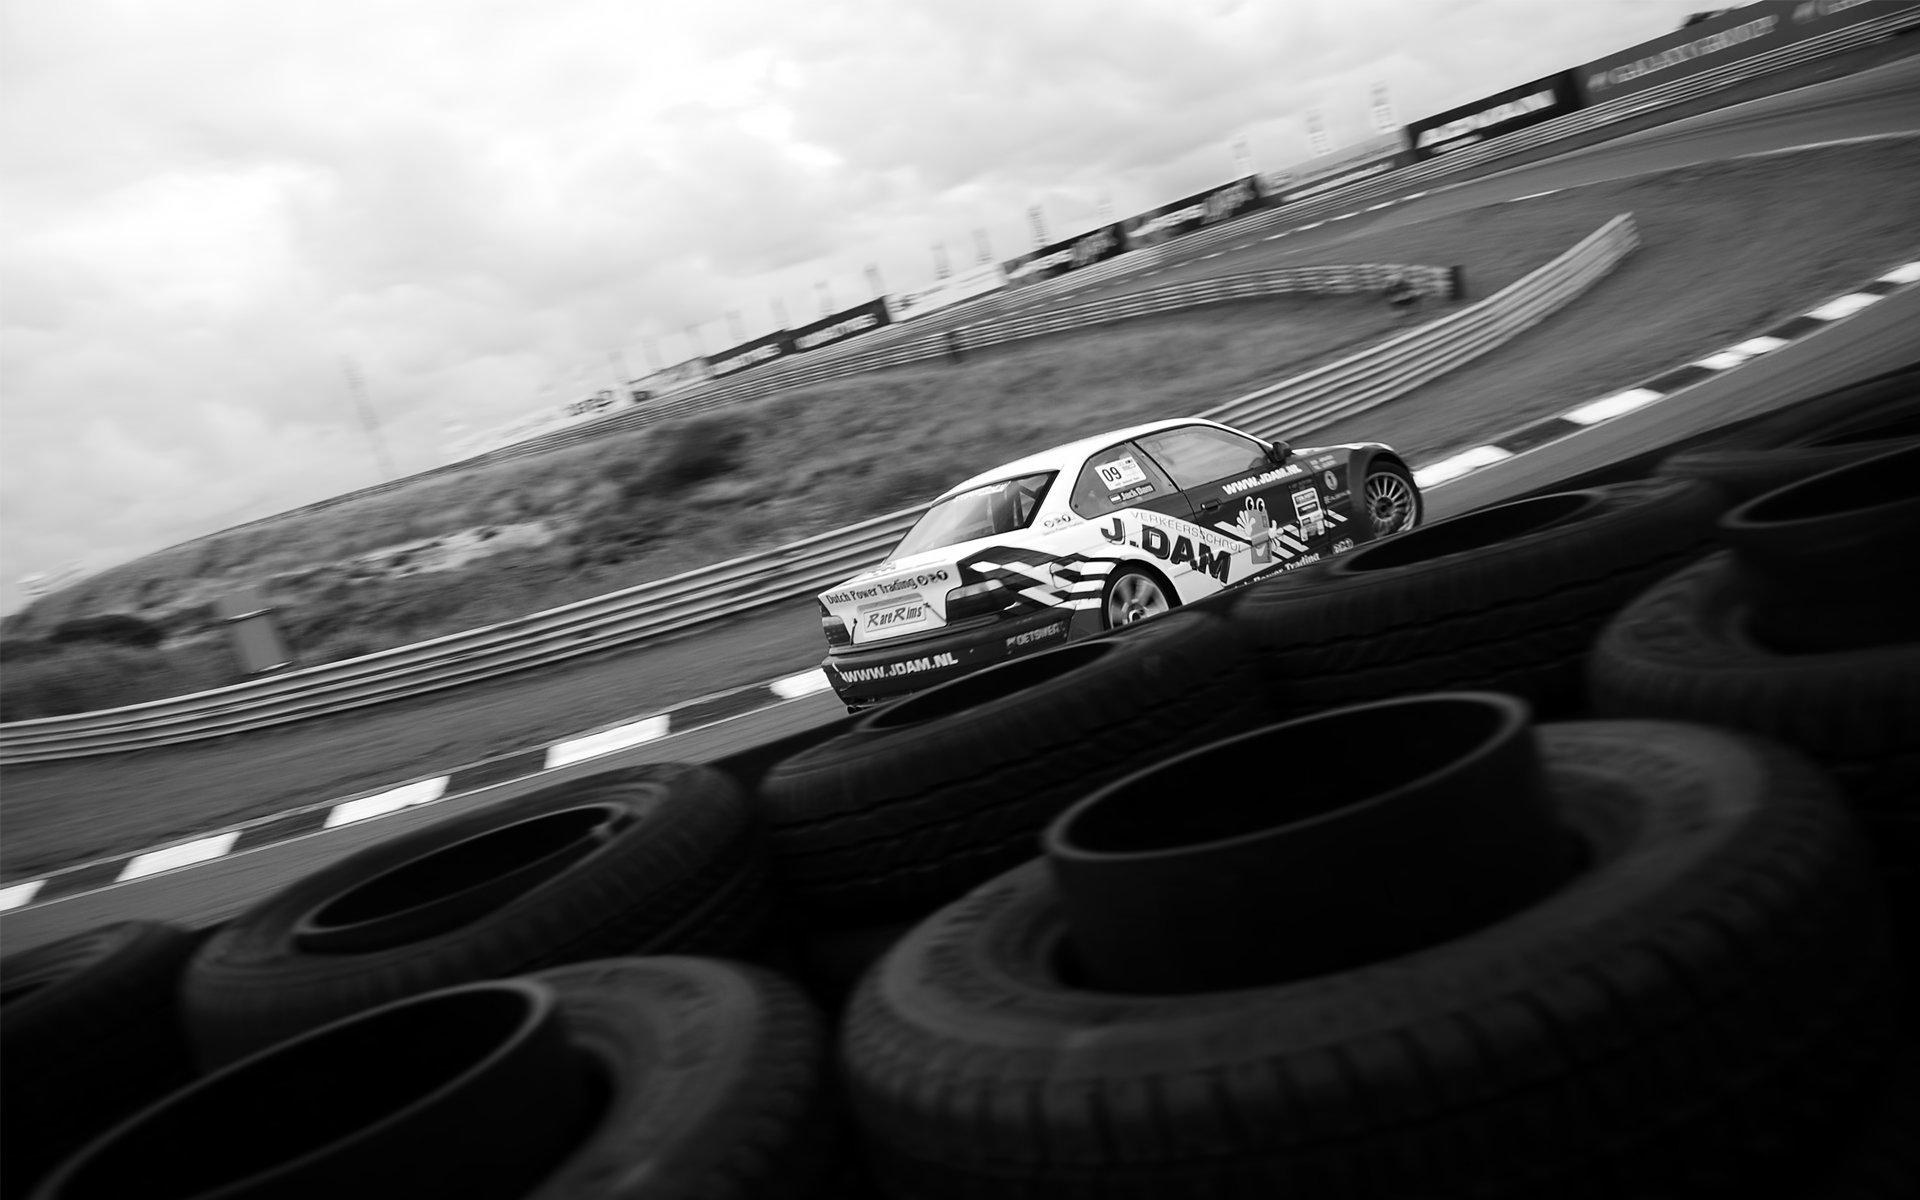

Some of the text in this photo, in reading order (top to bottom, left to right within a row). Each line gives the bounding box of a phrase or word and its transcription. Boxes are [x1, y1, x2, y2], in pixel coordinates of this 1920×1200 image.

[1101, 466, 1122, 482] 09
[1222, 464, 1303, 495] WWW.JDAM.NL
[1100, 517, 1232, 587] J.DAM
[825, 591, 851, 605] Dutch
[850, 587, 878, 601] Power
[877, 577, 919, 594] Trading
[841, 652, 959, 683] WWW.JDAM.NL
